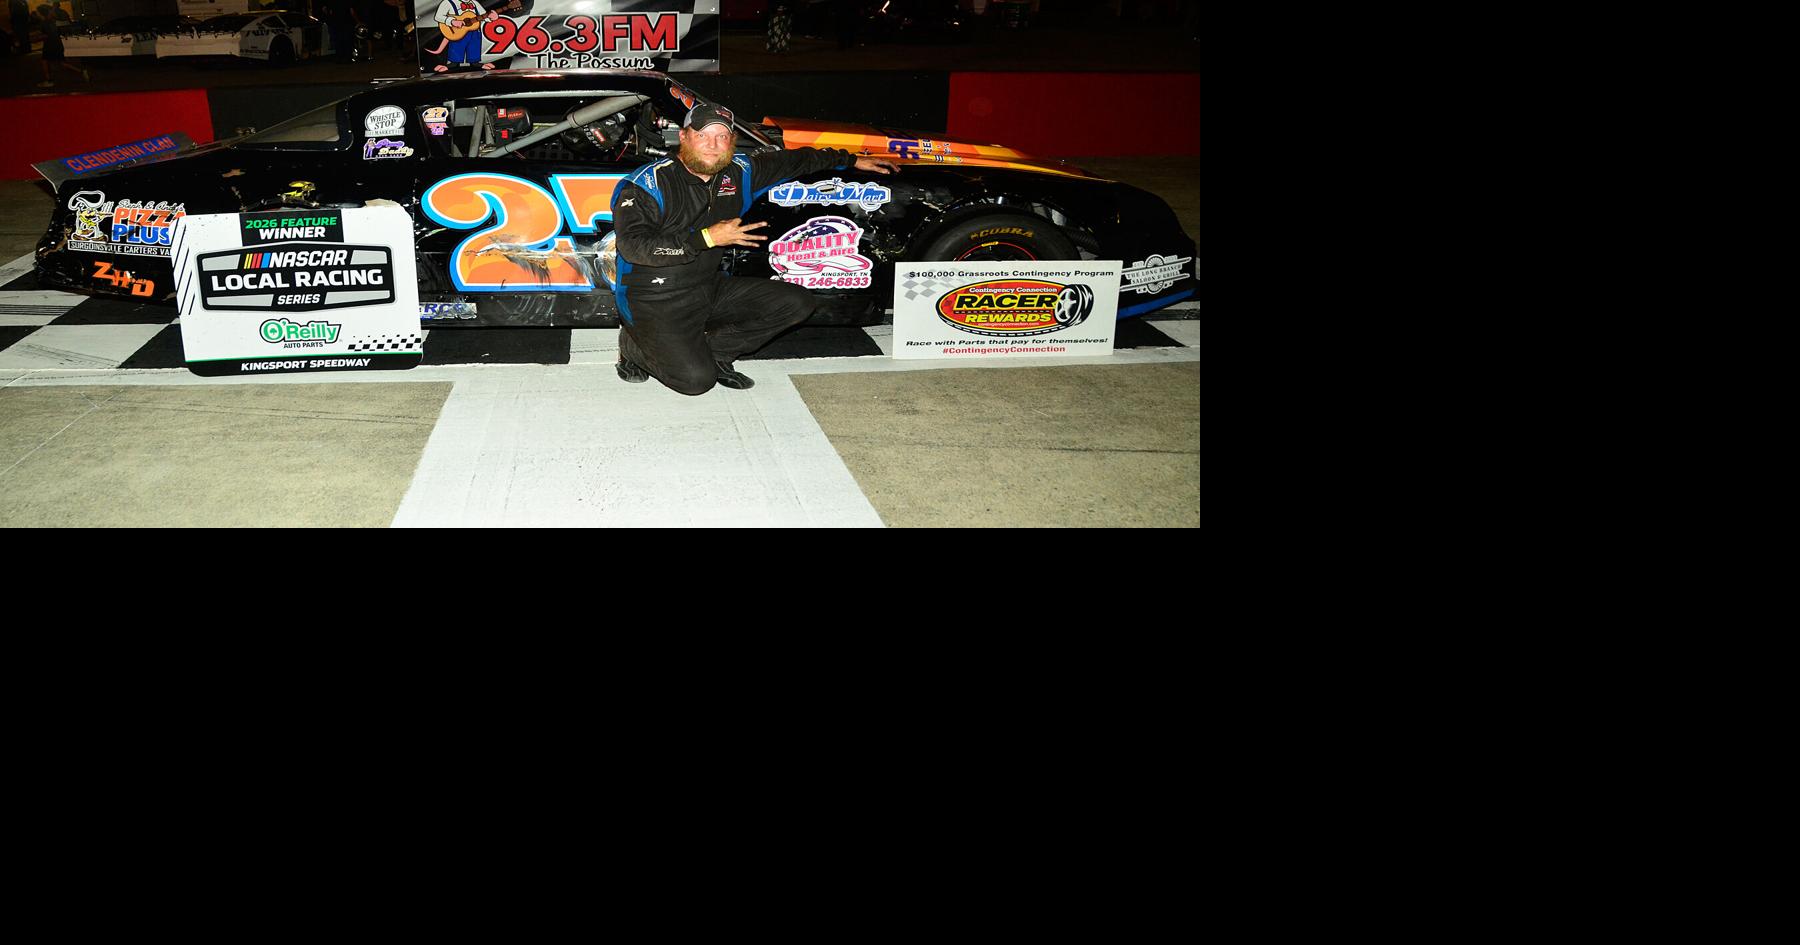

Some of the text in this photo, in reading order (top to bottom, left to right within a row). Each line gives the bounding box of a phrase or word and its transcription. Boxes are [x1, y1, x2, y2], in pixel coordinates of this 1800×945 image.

[536, 52, 652, 70] The Possum
[369, 112, 401, 123] WHISTLE
[374, 119, 397, 130] STOP
[67, 136, 177, 172] CLENDENIN CLAN
[778, 182, 884, 206] Dairy Mart
[246, 216, 338, 229] 2026 FEATURE
[112, 224, 171, 245] PLUS
[258, 226, 327, 240] WINNER
[979, 227, 1034, 239] COBRA
[125, 246, 158, 255] CARTERS
[772, 232, 858, 256] QUALITY
[270, 250, 349, 268] NASCAR
[787, 247, 856, 262] Heat & Aire
[211, 269, 385, 291] LOCAL RACING
[1127, 271, 1140, 279] THE
[807, 277, 869, 287] 246-6833
[277, 293, 321, 305] SERIES
[955, 294, 1059, 309] RACER
[965, 314, 1053, 324] REWARDS
[261, 319, 339, 342] O'Reilly
[943, 346, 1067, 354] #ContingencyConnection
[241, 358, 371, 371] KINGSPORT SPEEDWAY
